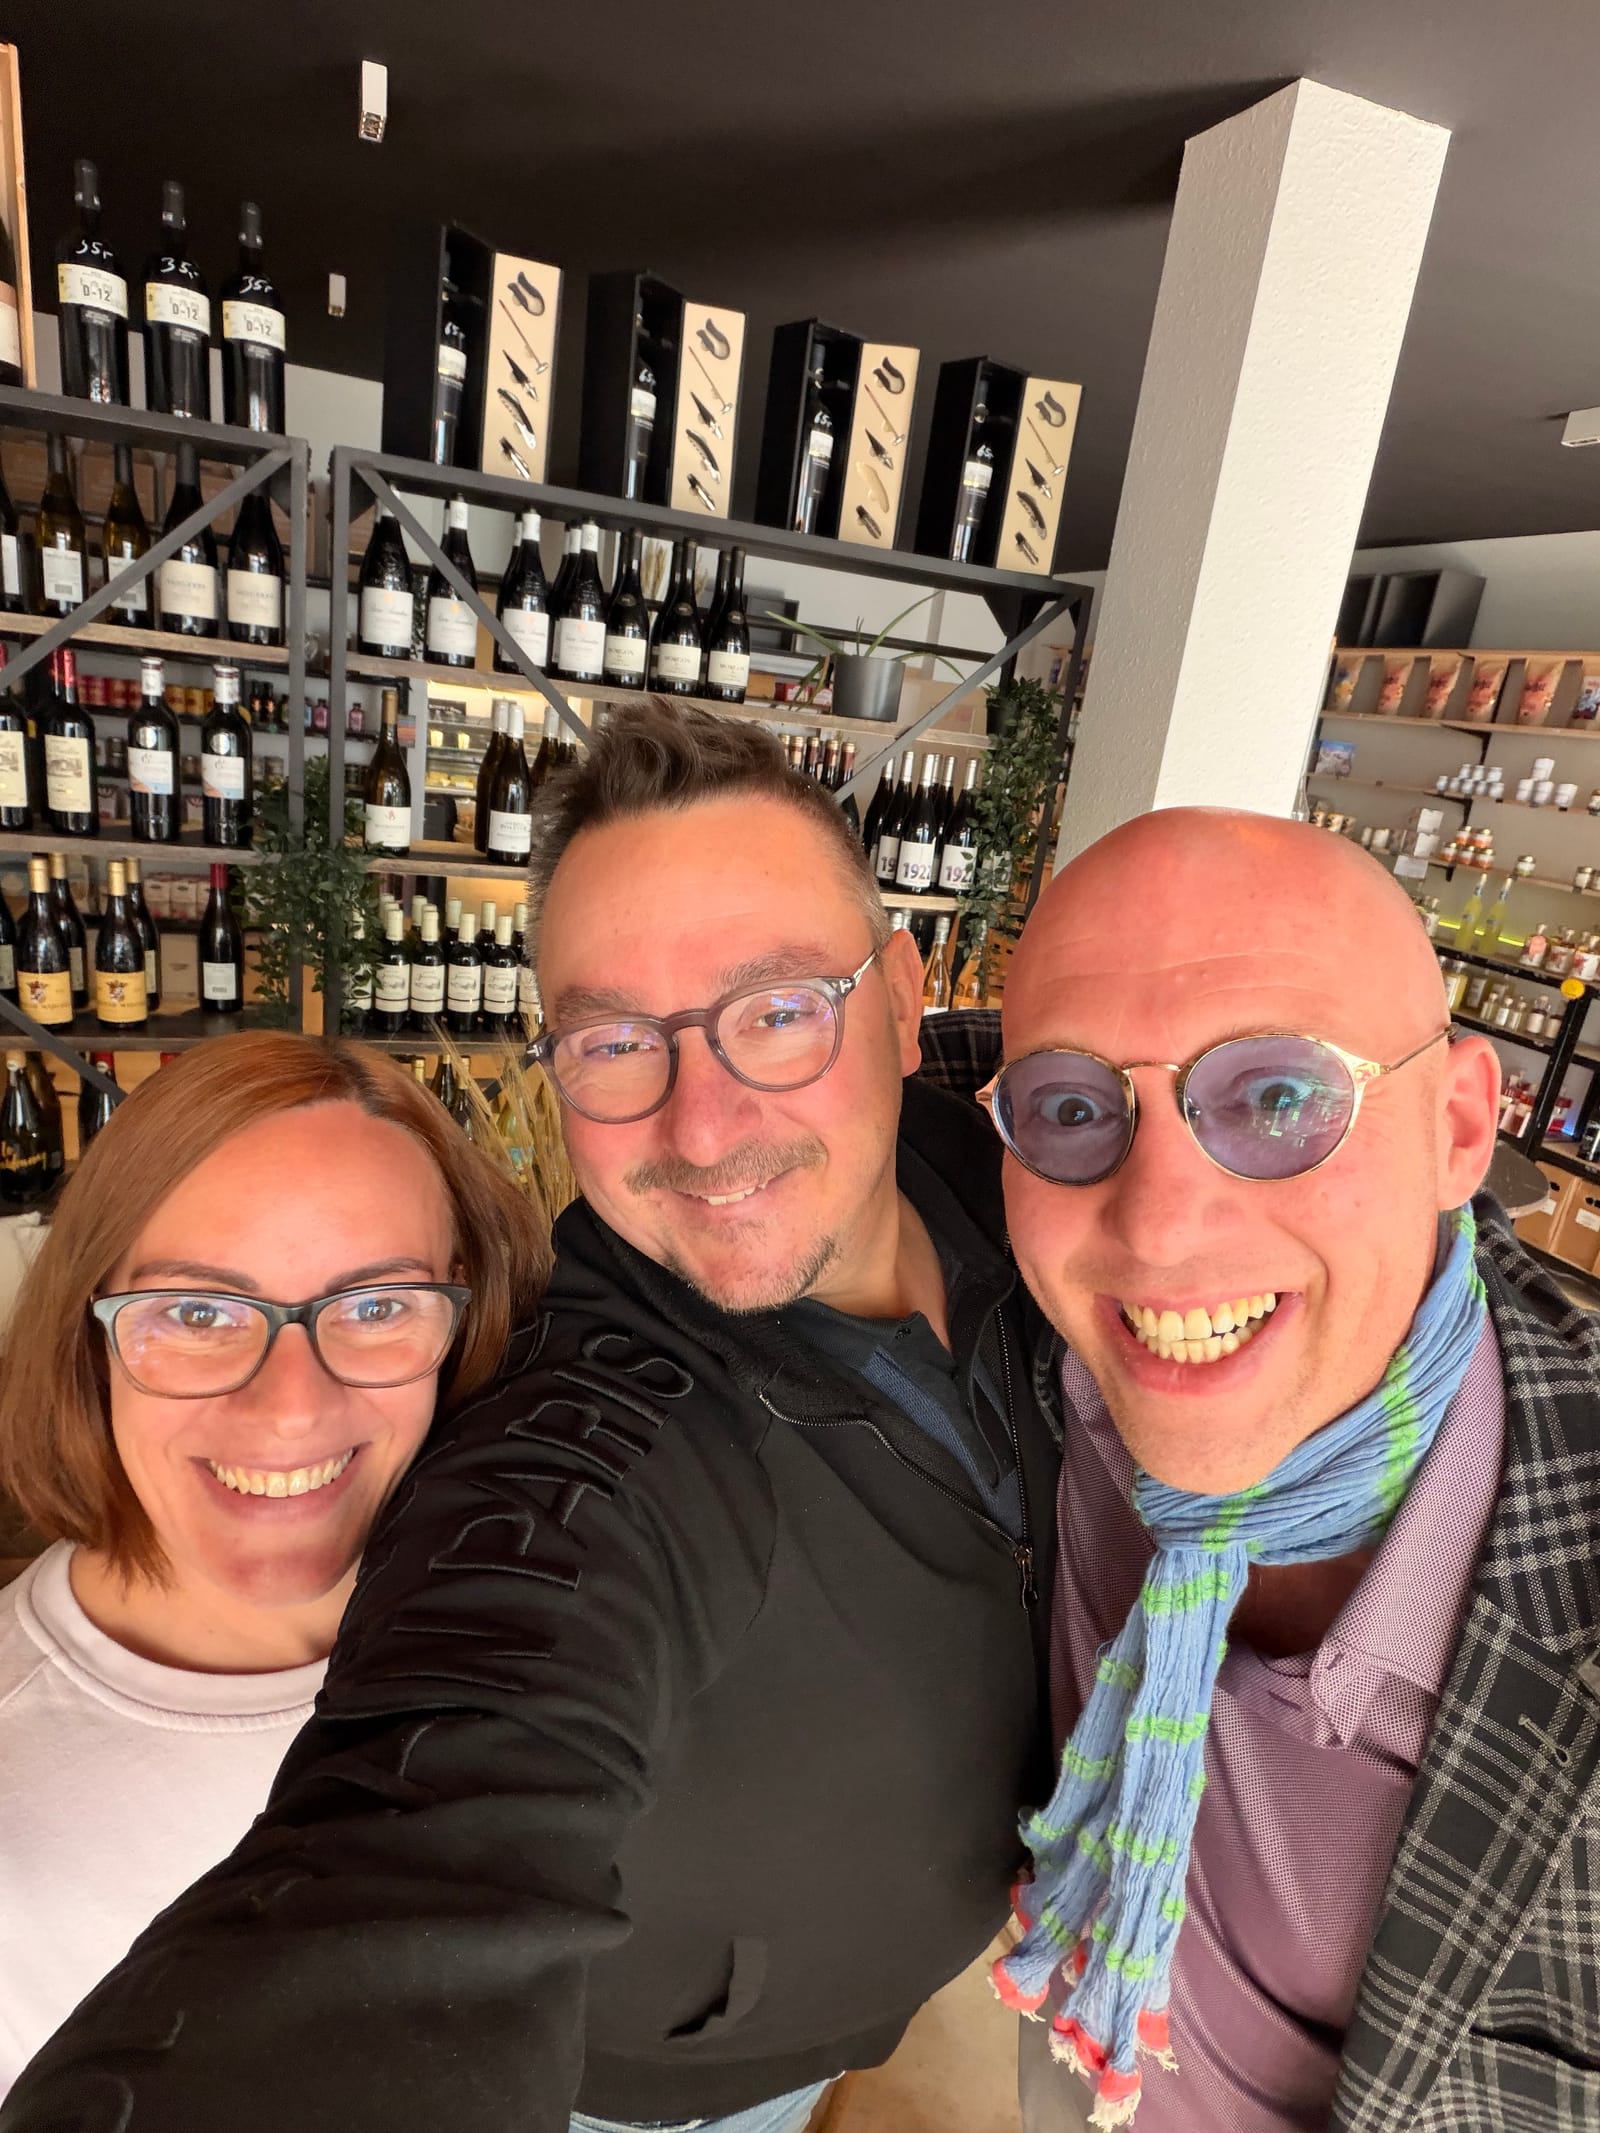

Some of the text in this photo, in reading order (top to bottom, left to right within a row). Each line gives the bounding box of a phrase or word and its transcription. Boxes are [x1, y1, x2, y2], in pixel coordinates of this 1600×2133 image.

[82, 283, 113, 302] D-12
[171, 302, 200, 321] D-12
[245, 319, 273, 337] D-12
[945, 864, 973, 883] 192
[429, 1323, 697, 1592] PARIS
